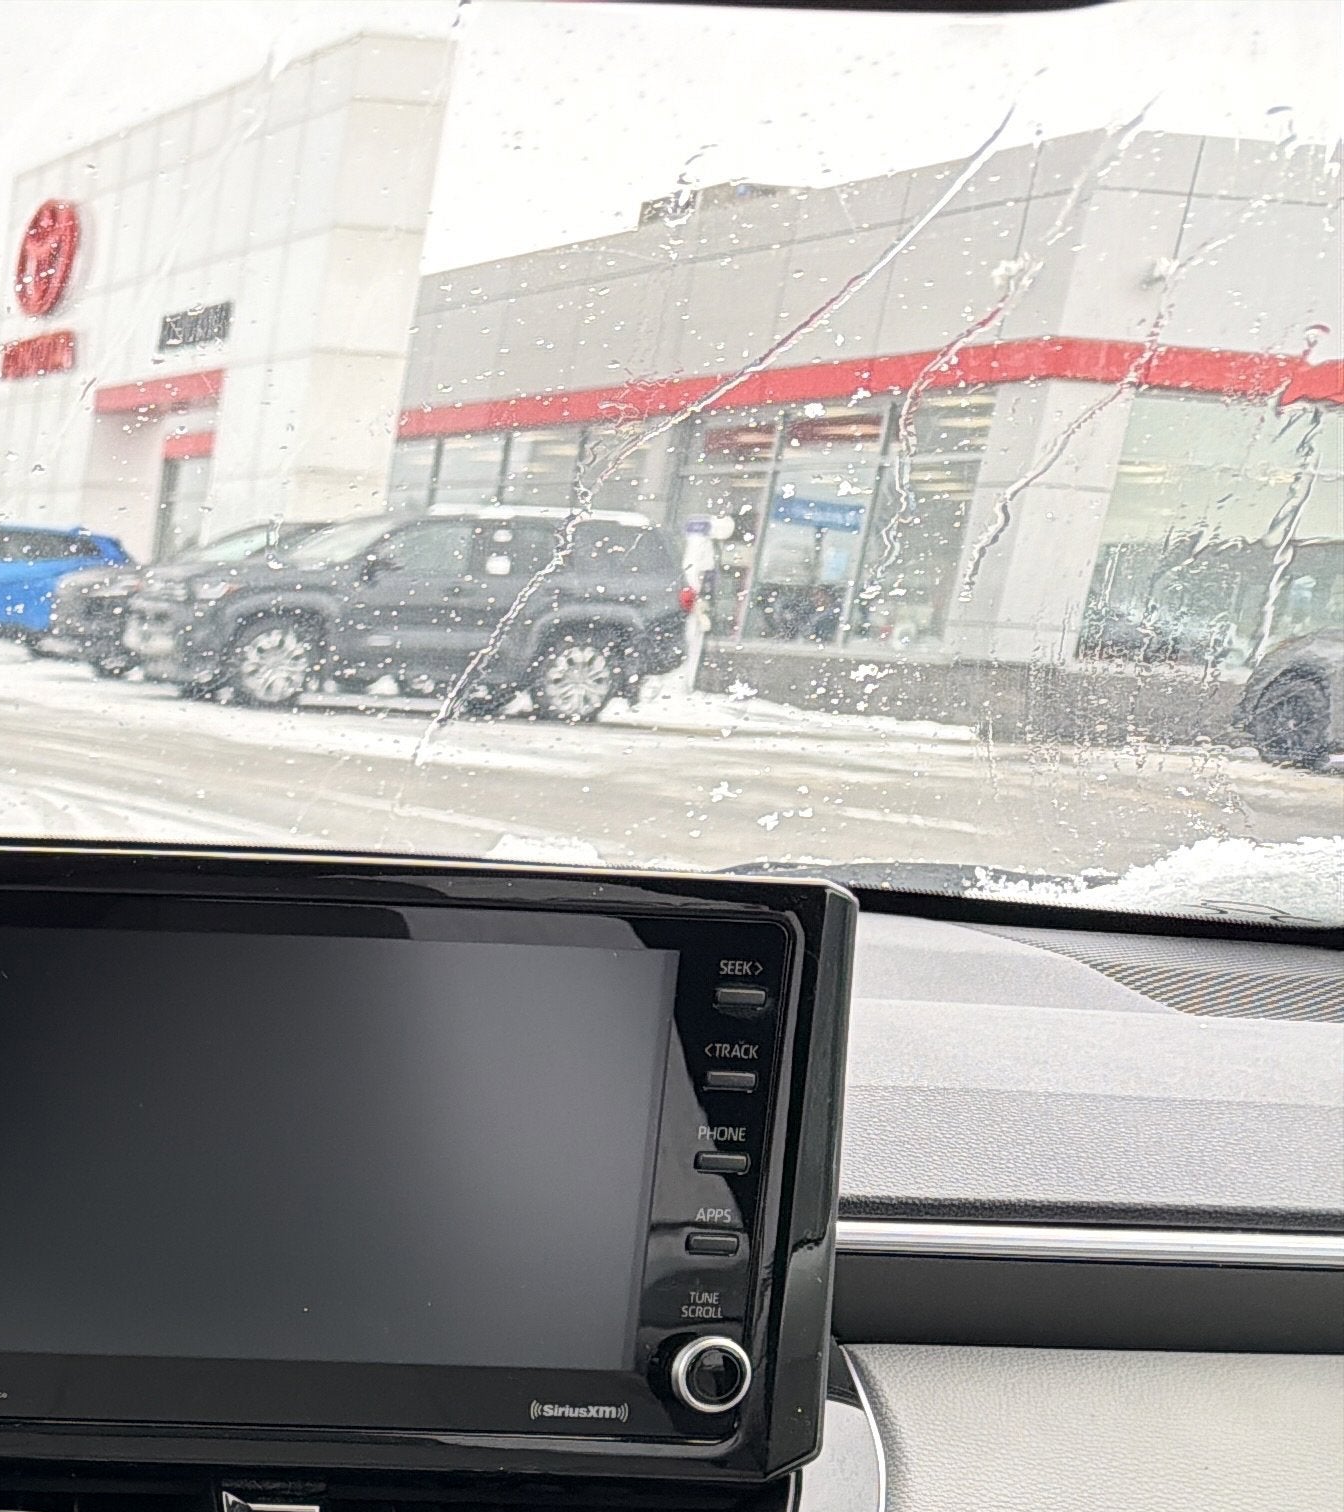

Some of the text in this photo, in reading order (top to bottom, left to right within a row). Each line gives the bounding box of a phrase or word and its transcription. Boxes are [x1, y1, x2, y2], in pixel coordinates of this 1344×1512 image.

[698, 1126, 747, 1143] PHONE
[695, 1208, 732, 1224] APPS
[689, 1291, 720, 1305] TUNE
[681, 1305, 724, 1320] SCROLL
